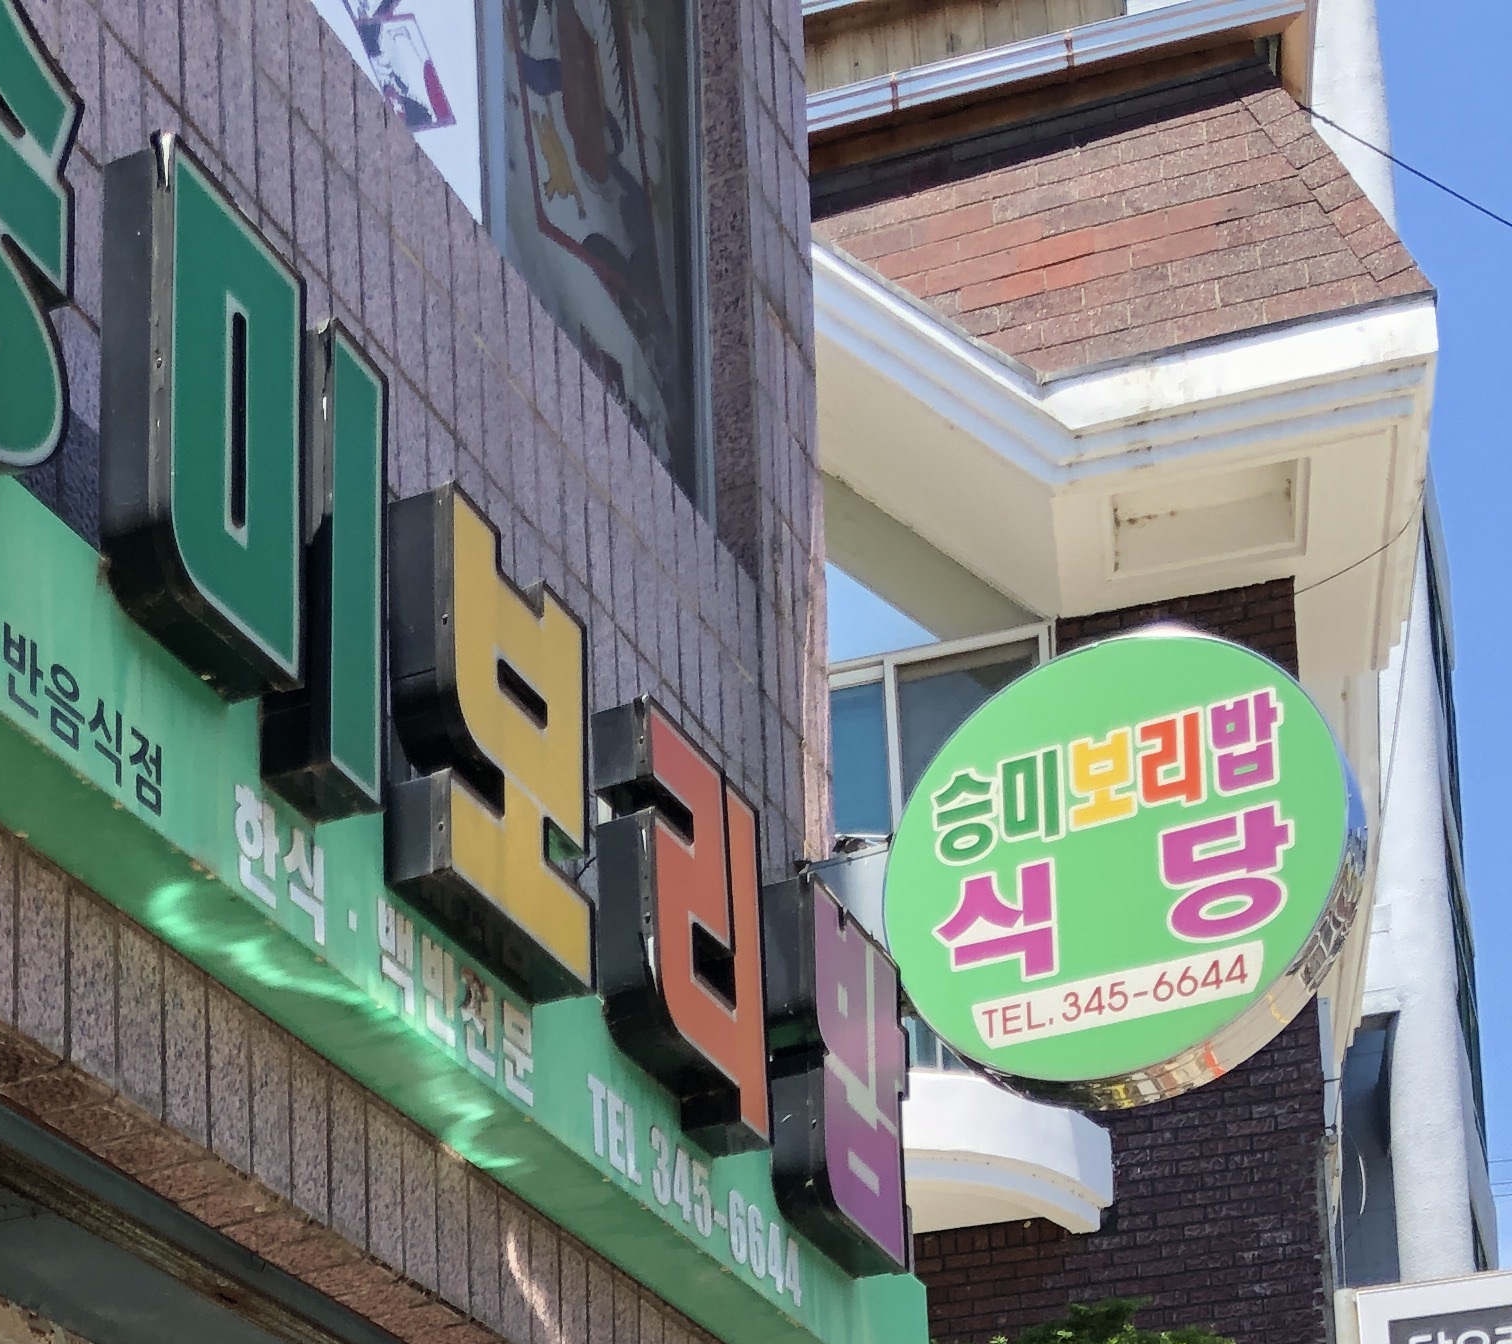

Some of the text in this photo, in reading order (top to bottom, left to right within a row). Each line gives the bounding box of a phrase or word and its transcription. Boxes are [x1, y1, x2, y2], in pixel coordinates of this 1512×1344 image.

[933, 690, 1281, 863] 승미보리밥
[234, 784, 326, 946] 한식
[587, 1072, 803, 1308] TEL 345-6644
